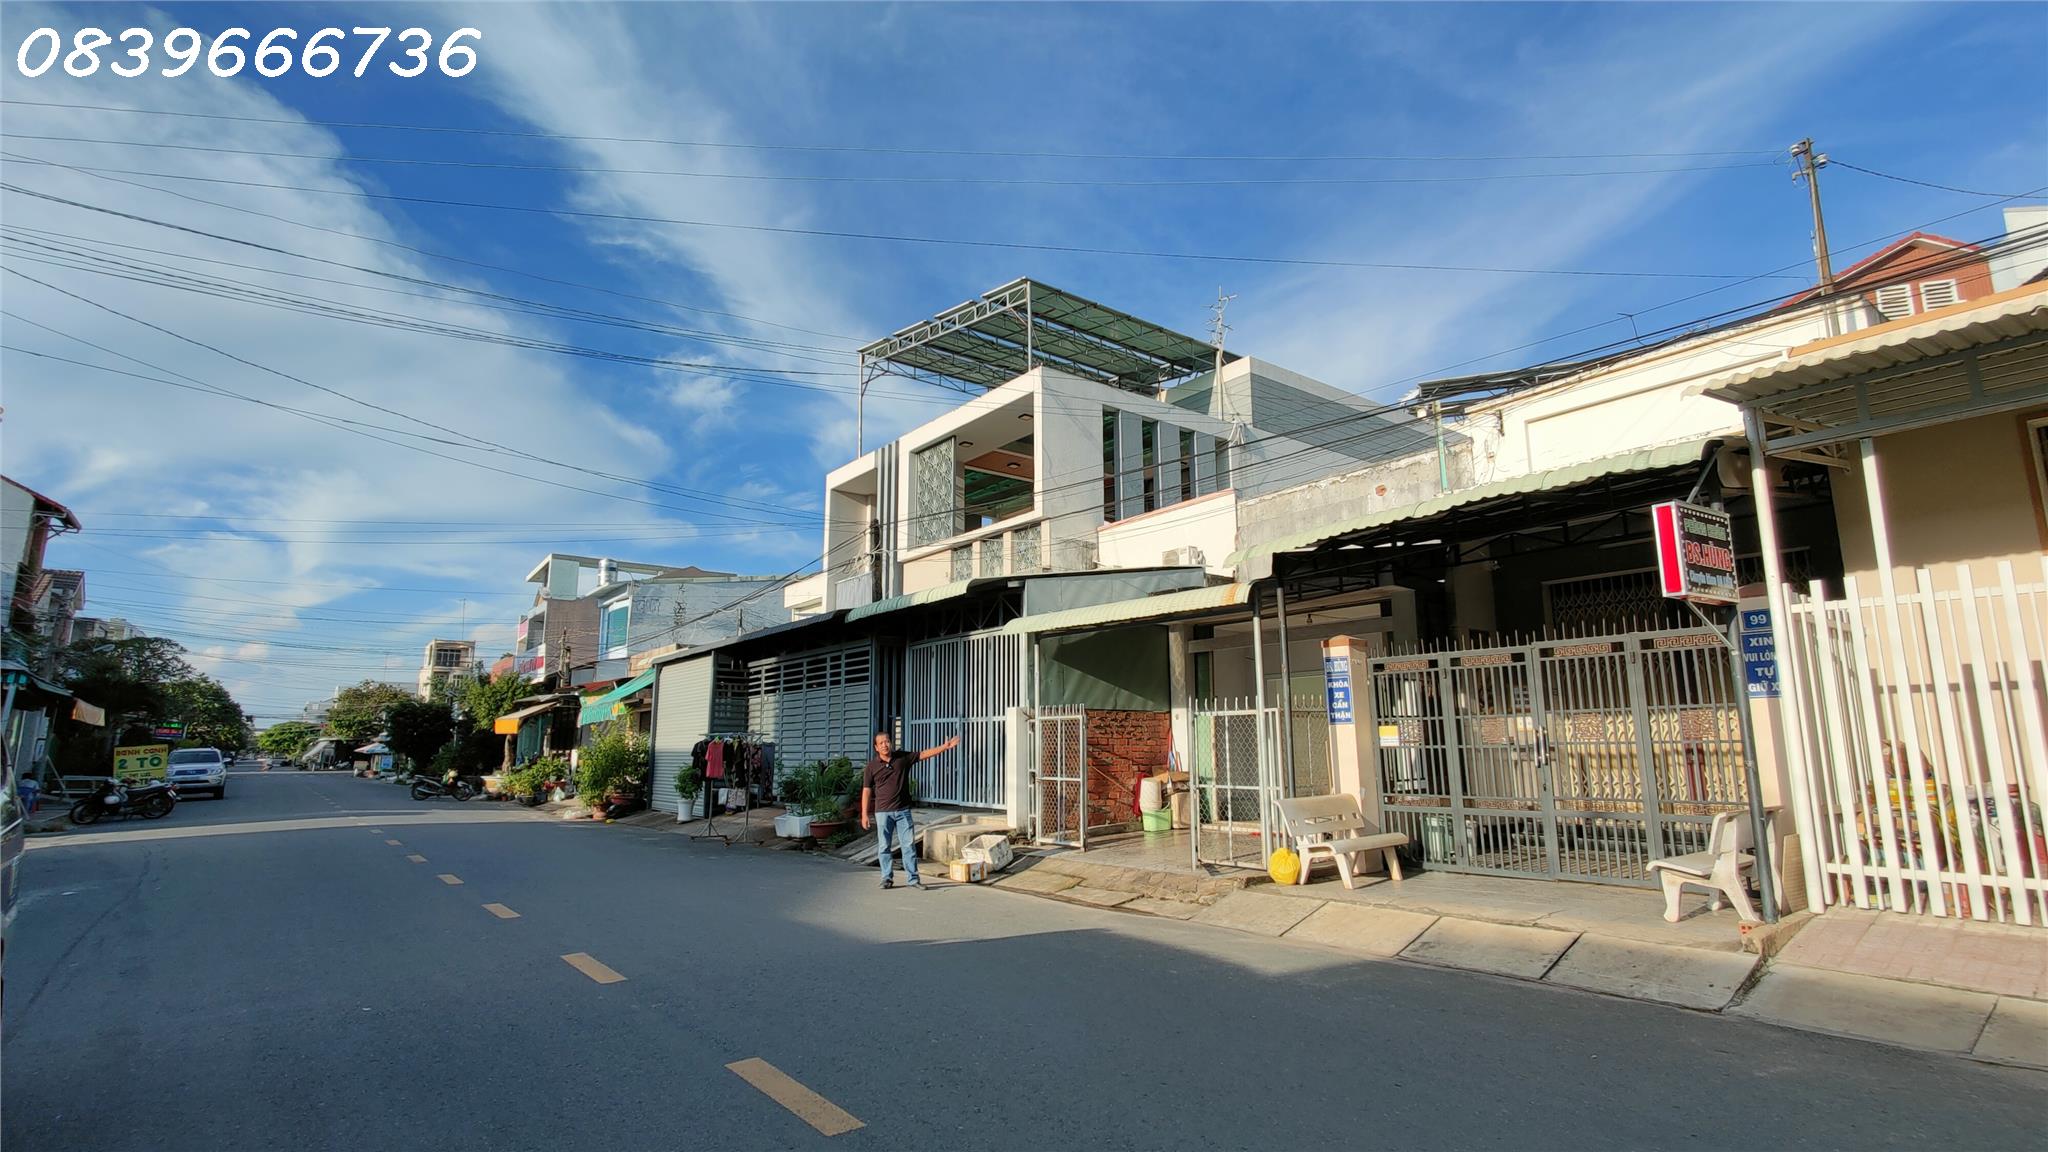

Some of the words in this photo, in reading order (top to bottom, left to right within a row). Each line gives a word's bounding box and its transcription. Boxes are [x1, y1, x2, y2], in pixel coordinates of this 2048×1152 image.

[1750, 614, 1767, 625] 99
[1749, 636, 1774, 647] XIN
[1743, 652, 1758, 662] VUI
[1754, 665, 1775, 679] TỰ
[1747, 680, 1769, 693] GIỮ
[1333, 691, 1344, 699] XE
[118, 759, 128, 769] 2
